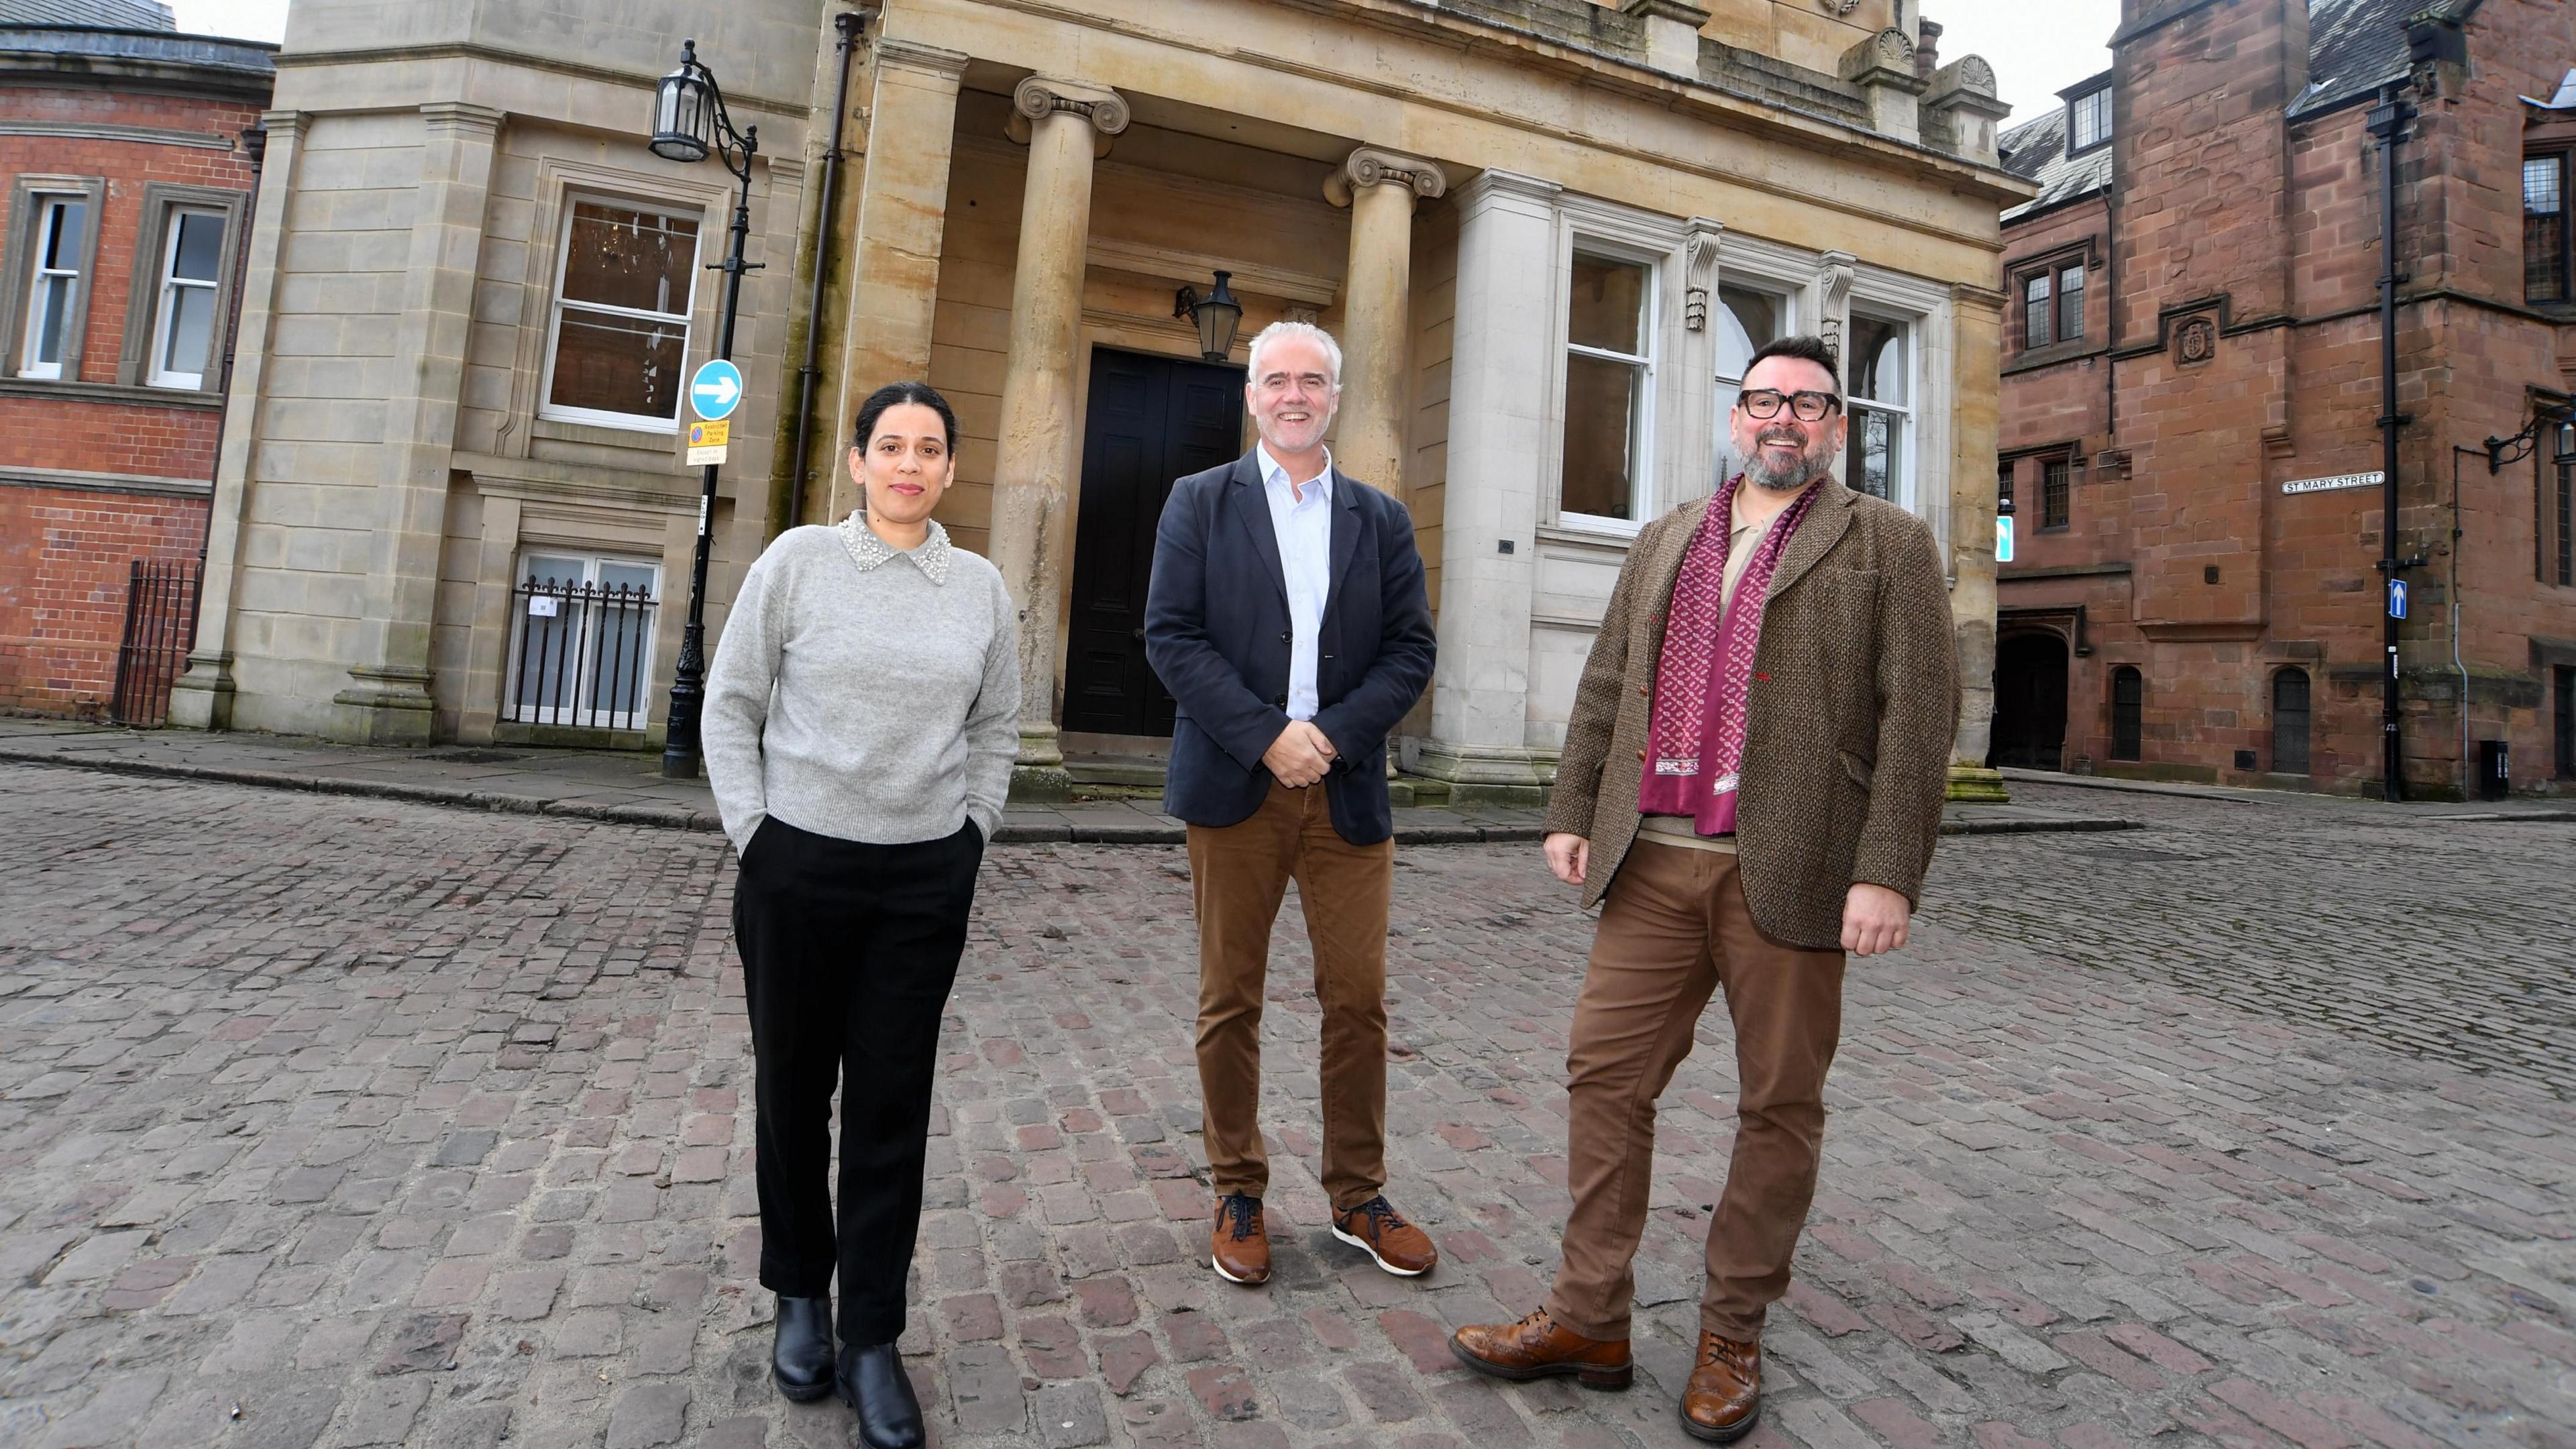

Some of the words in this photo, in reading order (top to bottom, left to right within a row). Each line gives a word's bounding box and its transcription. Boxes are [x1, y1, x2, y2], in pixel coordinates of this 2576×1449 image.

[2287, 483, 2300, 492] ST
[2302, 479, 2334, 490] MARY
[2337, 474, 2379, 486] STREET
